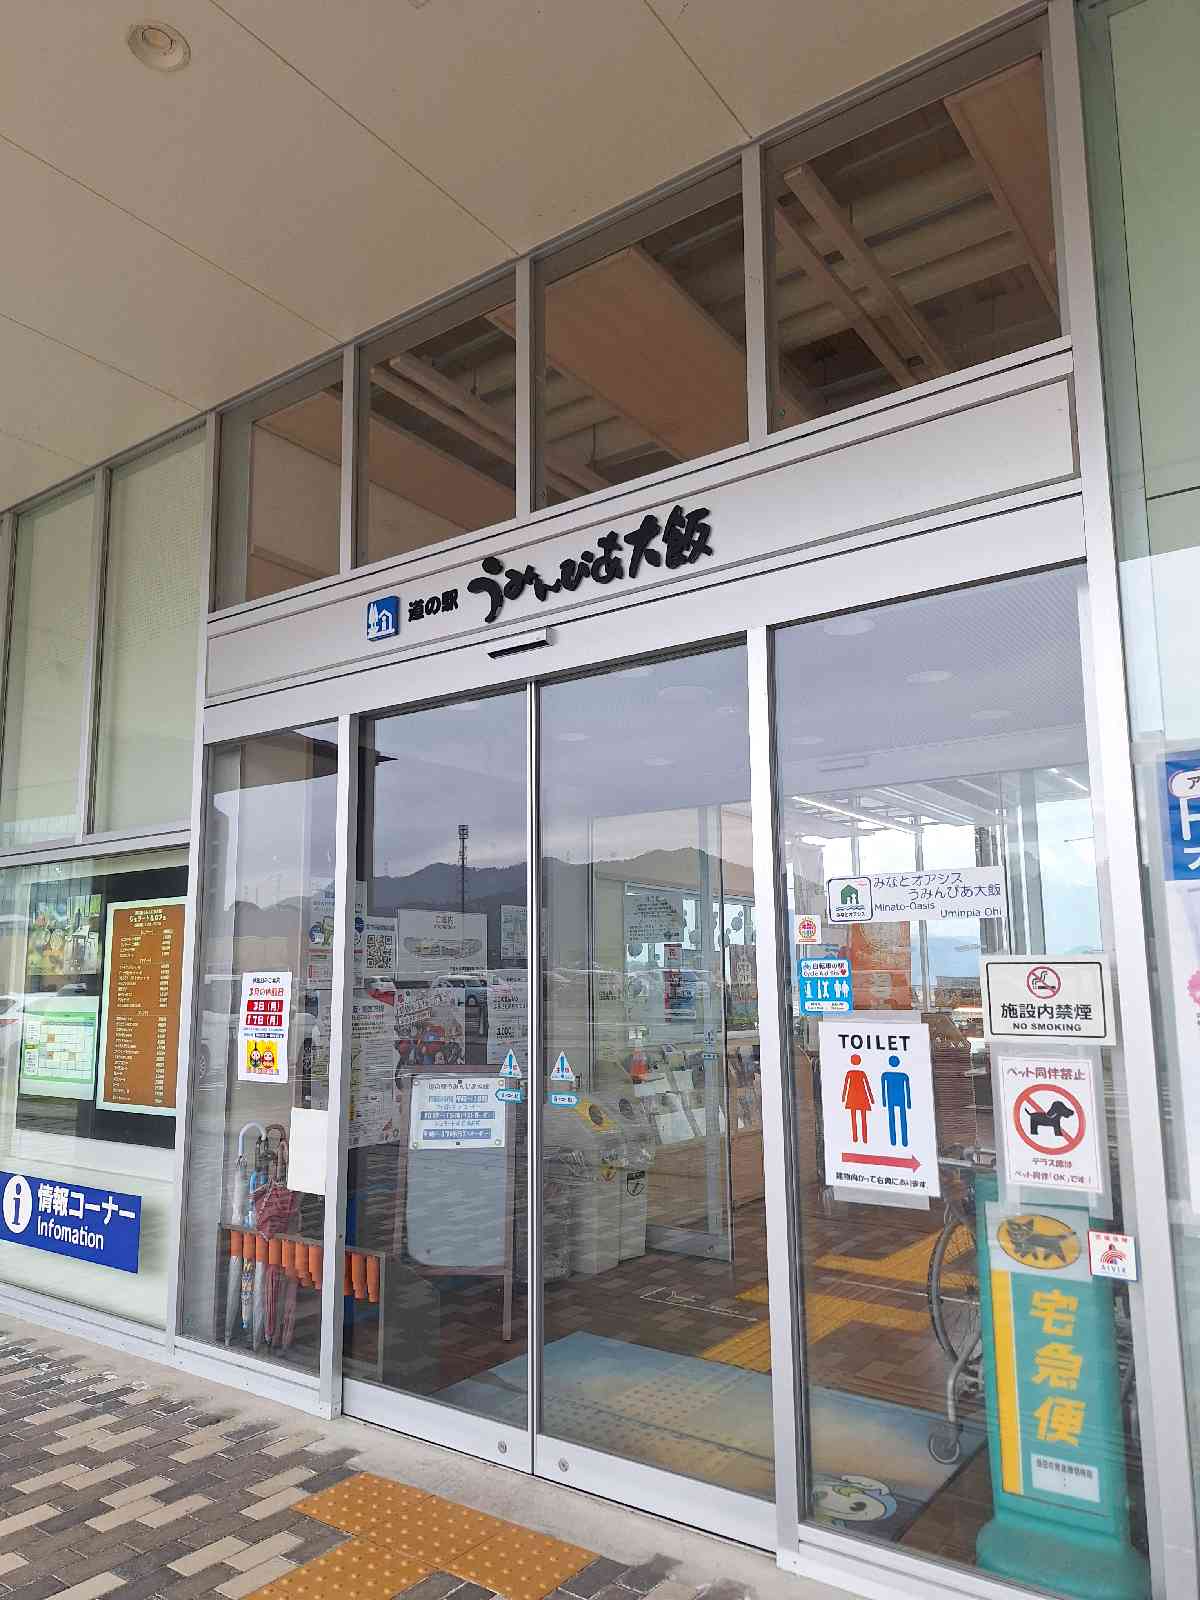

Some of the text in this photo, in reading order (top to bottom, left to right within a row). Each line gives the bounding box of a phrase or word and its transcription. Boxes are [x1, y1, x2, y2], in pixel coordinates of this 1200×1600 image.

[408, 505, 713, 623] 道の駅 うみんぴあ大飯
[873, 872, 964, 889] みなとオアシス
[908, 883, 1001, 901] うみんぴあ大飯
[874, 902, 1002, 918] Minato-Oasis Uminpia Ohi
[1001, 1003, 1093, 1020] 施設内禁煙
[1031, 1023, 1082, 1032] SMOKING
[838, 1034, 911, 1051] TOILET
[1007, 1066, 1086, 1081] ペット同伴禁止
[38, 1183, 136, 1225] 情報コーナー
[38, 1216, 104, 1250] Infomation
[1029, 1288, 1087, 1447] 宅急便
